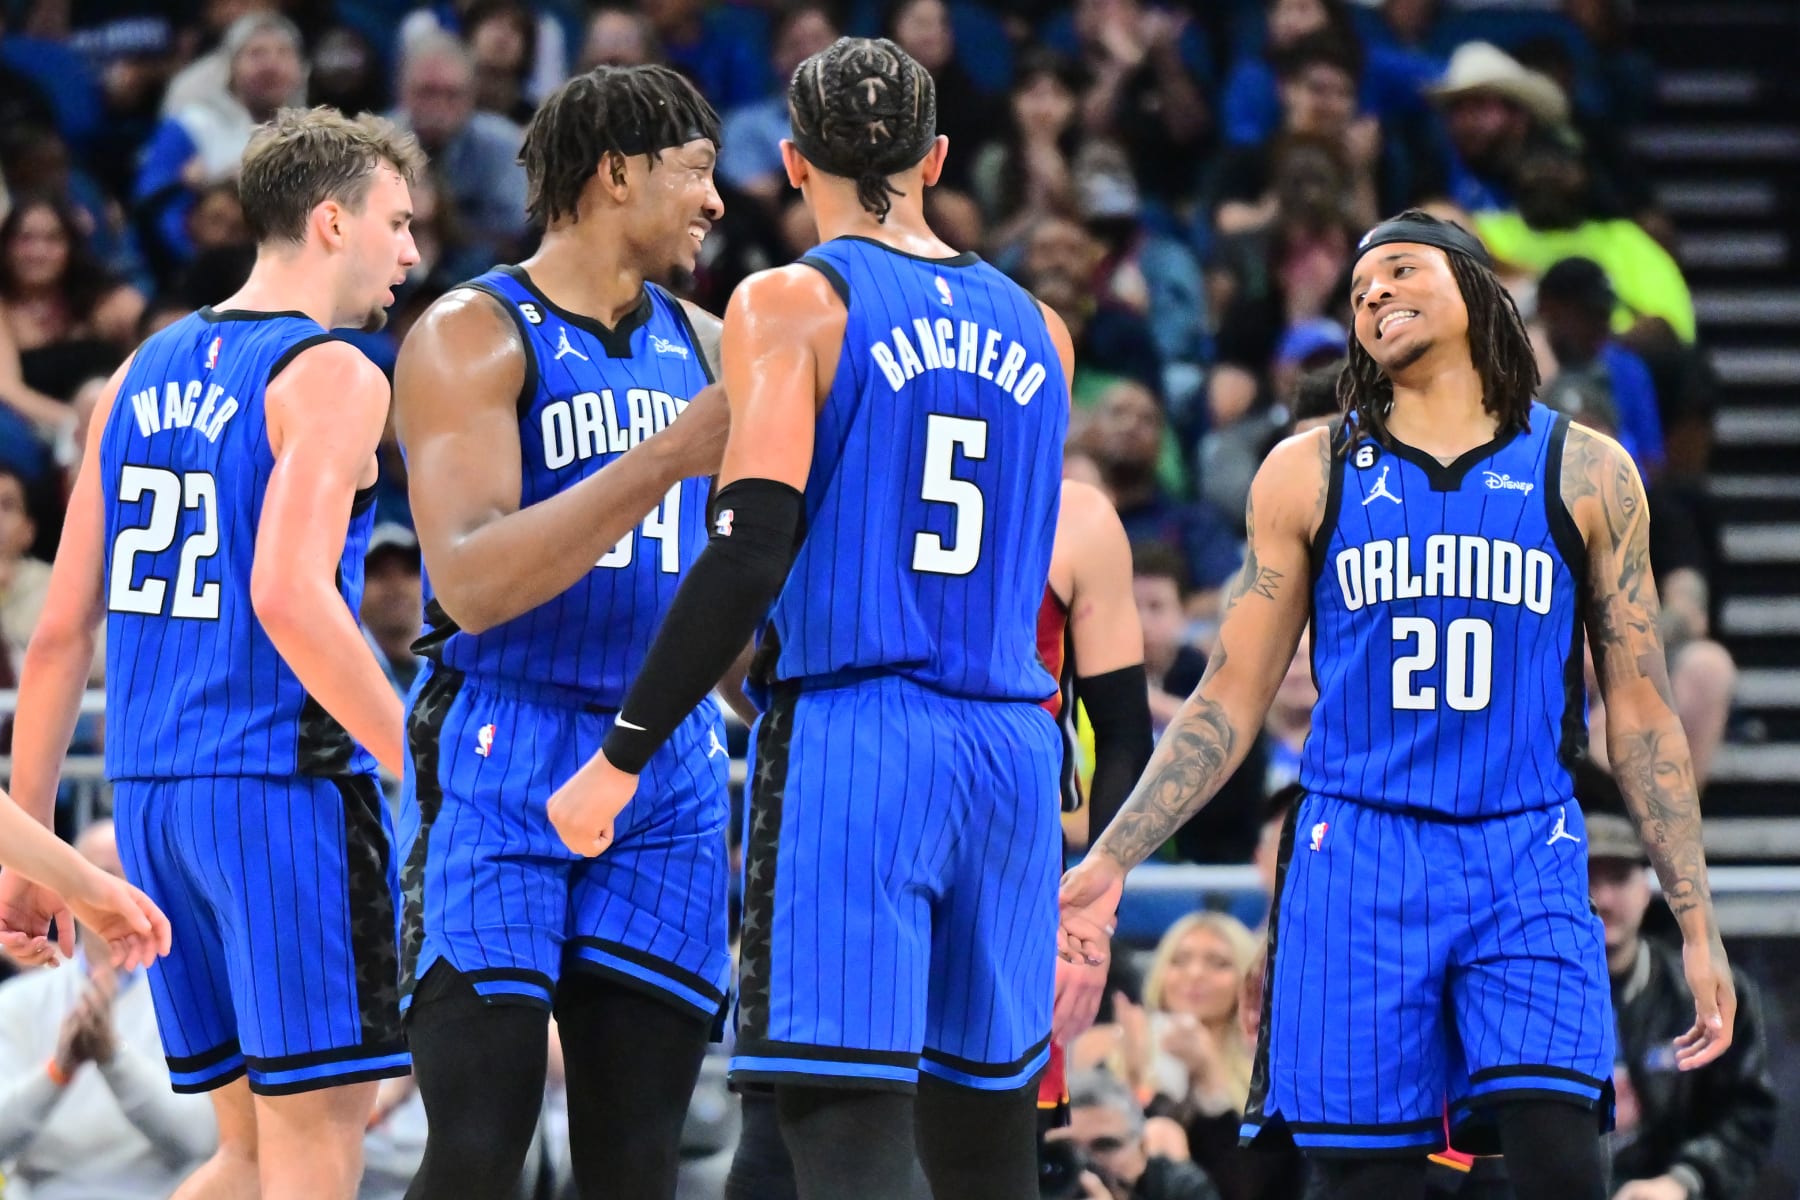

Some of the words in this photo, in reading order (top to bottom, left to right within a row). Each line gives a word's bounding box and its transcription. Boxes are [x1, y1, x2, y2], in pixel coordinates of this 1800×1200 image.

[518, 302, 542, 324] 6
[869, 317, 1047, 406] BANCHERO
[131, 379, 239, 443] WAGER
[540, 387, 690, 471] ORLAN
[911, 412, 988, 576] 5
[1356, 445, 1374, 468] 6
[107, 464, 220, 620] 22
[1335, 533, 1554, 616] ORLANDO
[1391, 616, 1493, 712] 20
